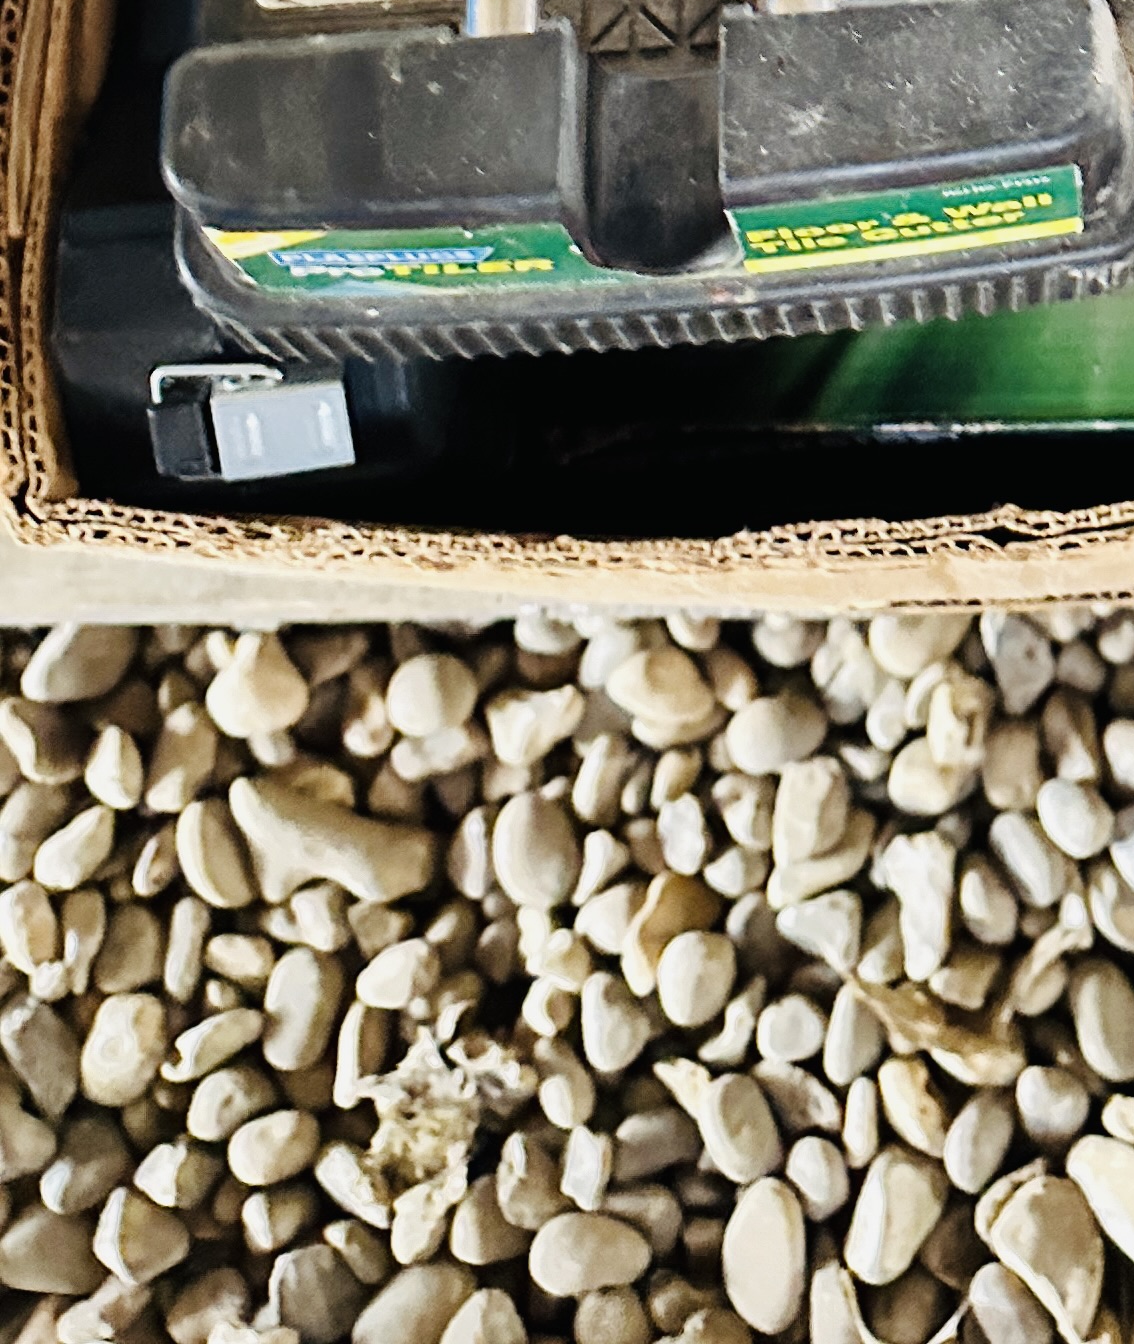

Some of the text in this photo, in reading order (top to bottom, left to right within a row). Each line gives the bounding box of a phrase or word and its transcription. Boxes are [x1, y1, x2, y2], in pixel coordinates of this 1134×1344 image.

[745, 192, 1053, 245] Floor & Wall
[750, 210, 1027, 255] Tile Cutter
[289, 259, 554, 277] ProTILER
